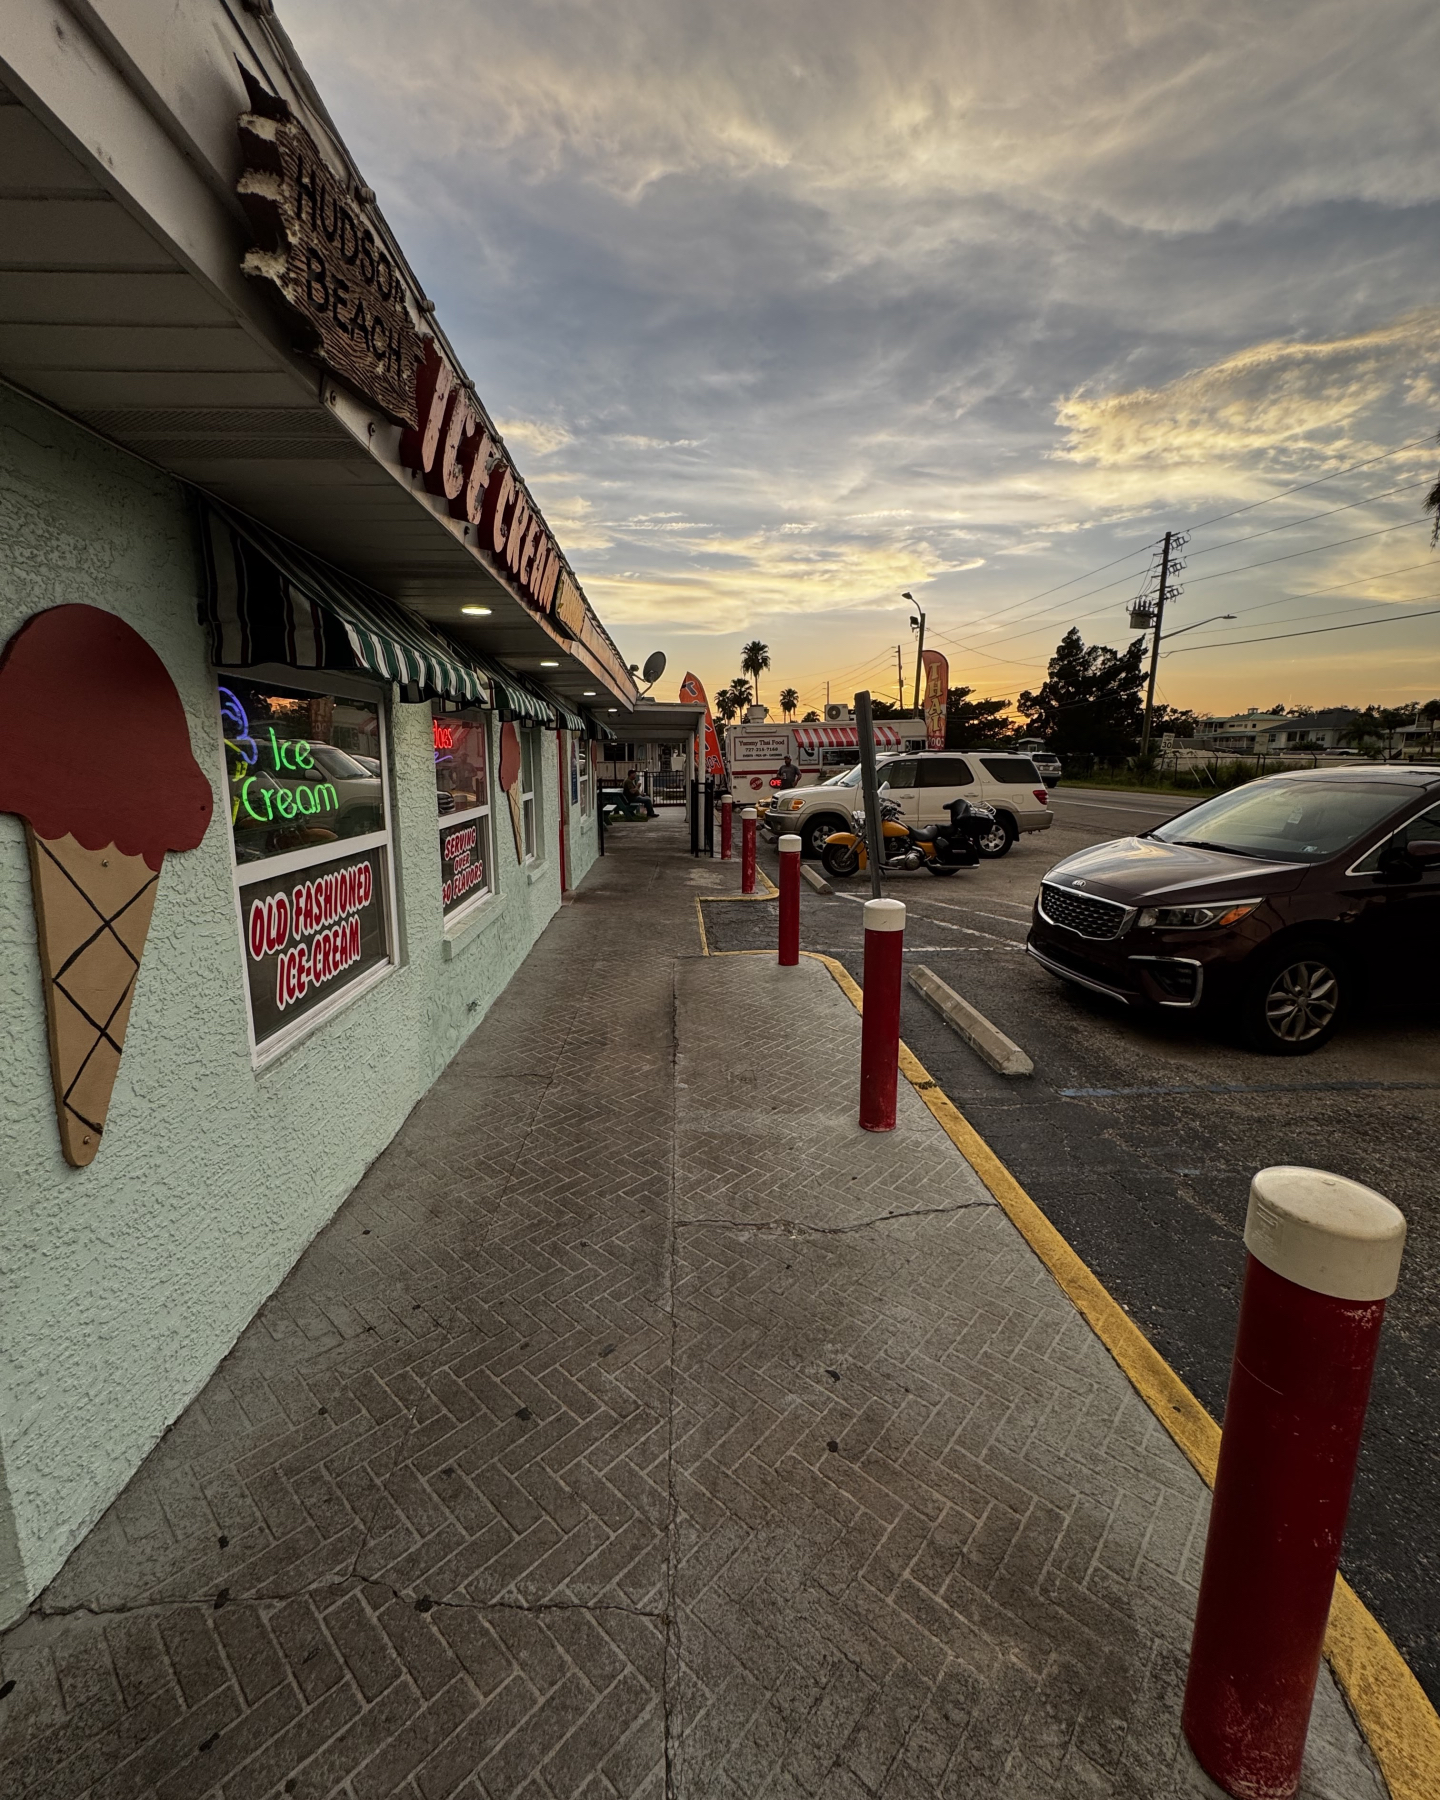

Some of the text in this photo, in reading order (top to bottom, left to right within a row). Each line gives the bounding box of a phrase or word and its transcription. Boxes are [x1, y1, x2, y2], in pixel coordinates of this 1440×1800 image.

[305, 246, 402, 382] BEACH
[421, 363, 561, 615] ICE CREAM
[928, 662, 945, 732] THAI
[268, 727, 315, 771] Ice
[241, 776, 340, 822] Cream
[444, 826, 477, 861] SERVING
[454, 851, 471, 874] OVER
[453, 860, 484, 899] FLAVORS
[250, 861, 373, 961] OLD FASHIONED
[276, 914, 361, 1011] ICE-CREAM
